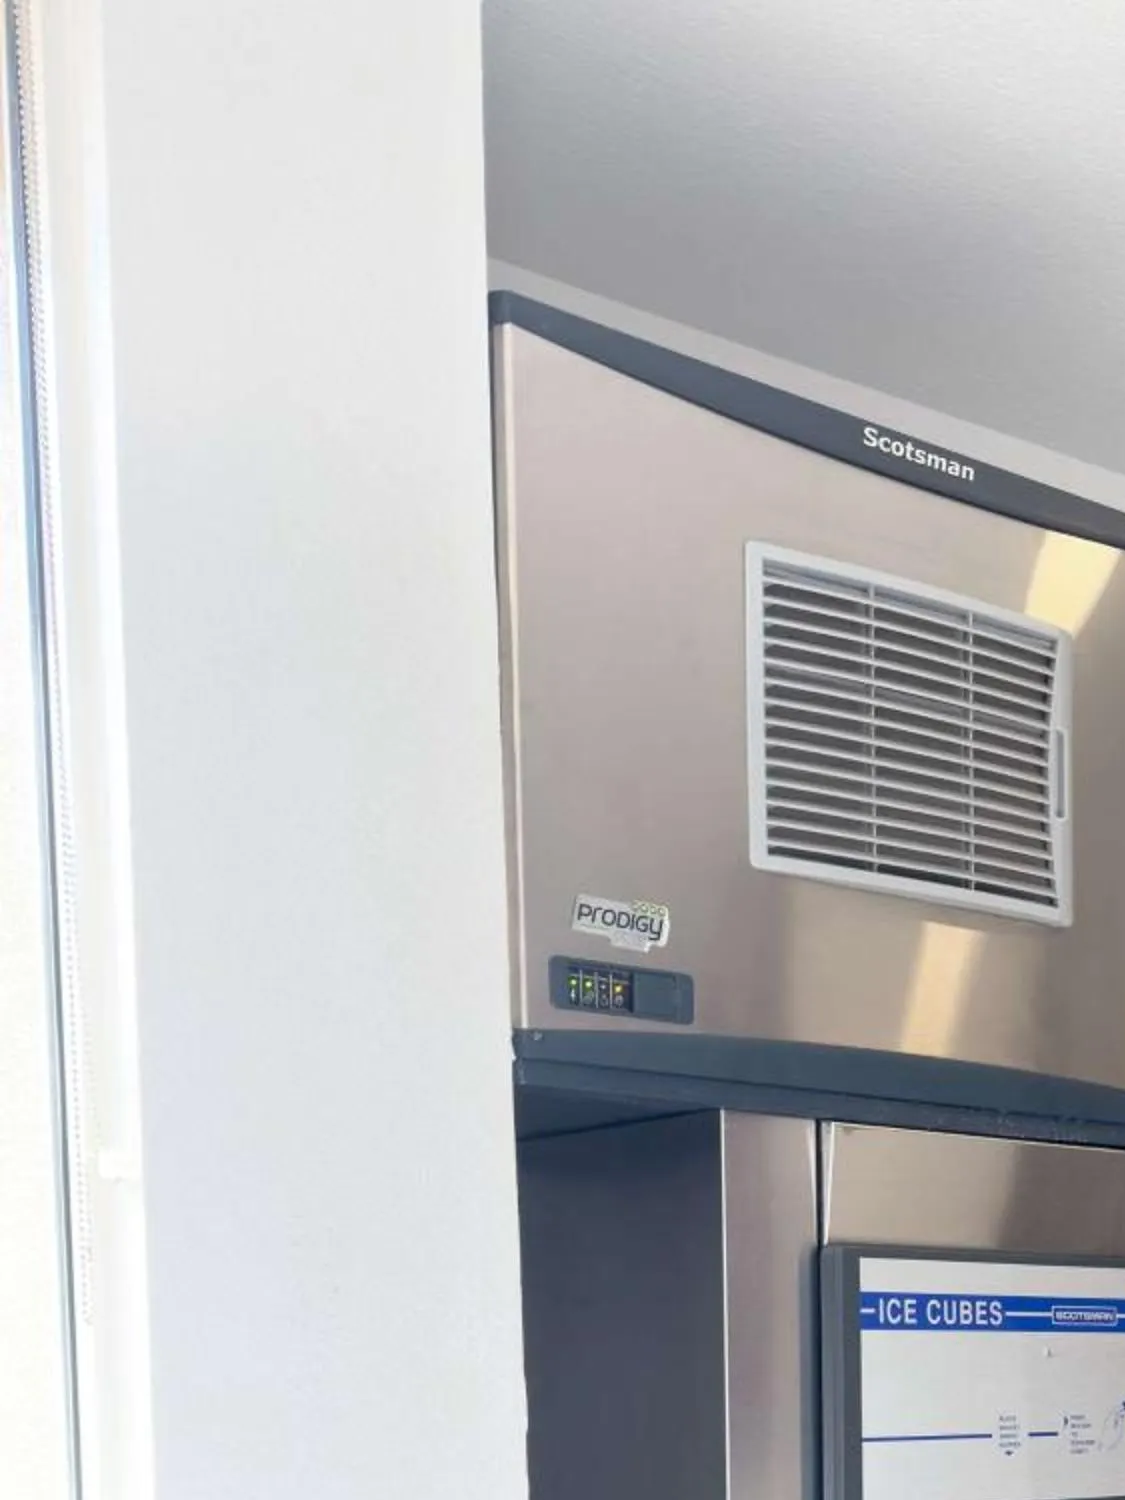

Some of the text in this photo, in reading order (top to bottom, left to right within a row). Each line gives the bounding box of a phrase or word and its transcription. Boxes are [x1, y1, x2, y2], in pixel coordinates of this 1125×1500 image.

[863, 426, 975, 481] Scotsman
[878, 1298, 1003, 1326] ICE CUBES
